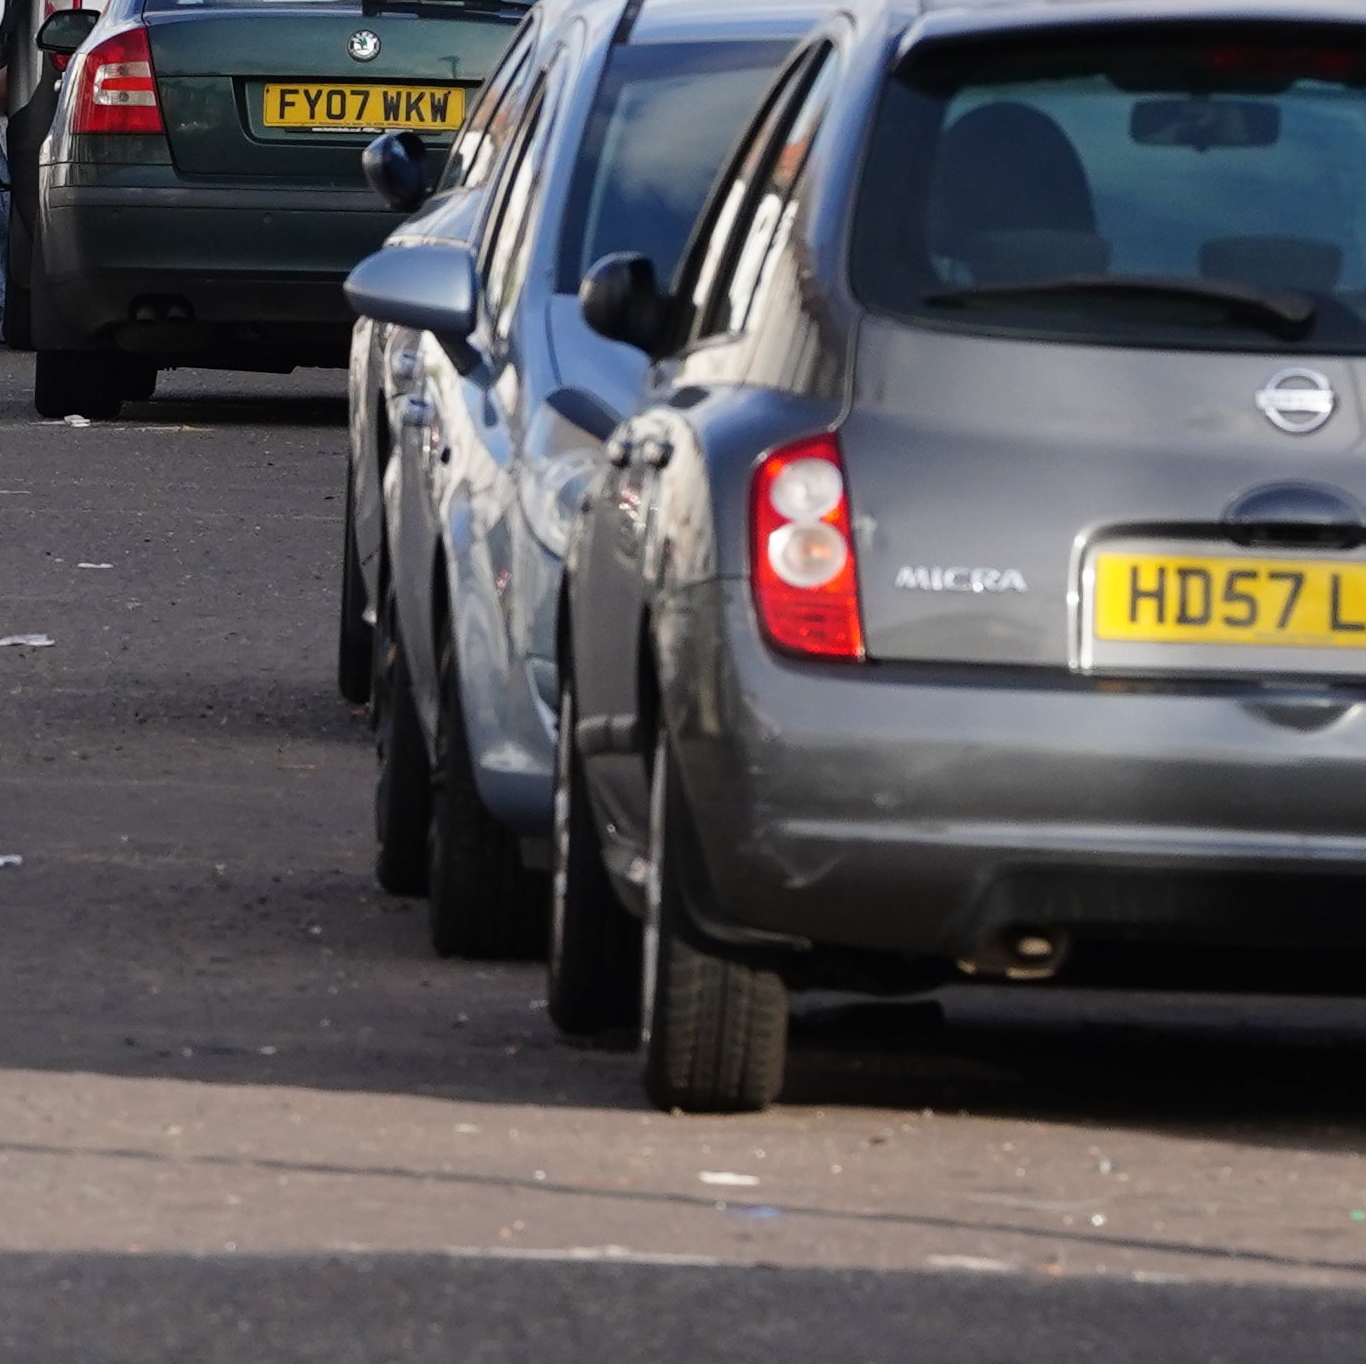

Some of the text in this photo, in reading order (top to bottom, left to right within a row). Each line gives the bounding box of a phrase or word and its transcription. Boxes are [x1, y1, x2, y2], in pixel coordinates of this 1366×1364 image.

[278, 88, 450, 123] FY07 WKW
[893, 564, 1030, 593] MICRA
[1128, 565, 1306, 630] HD57
